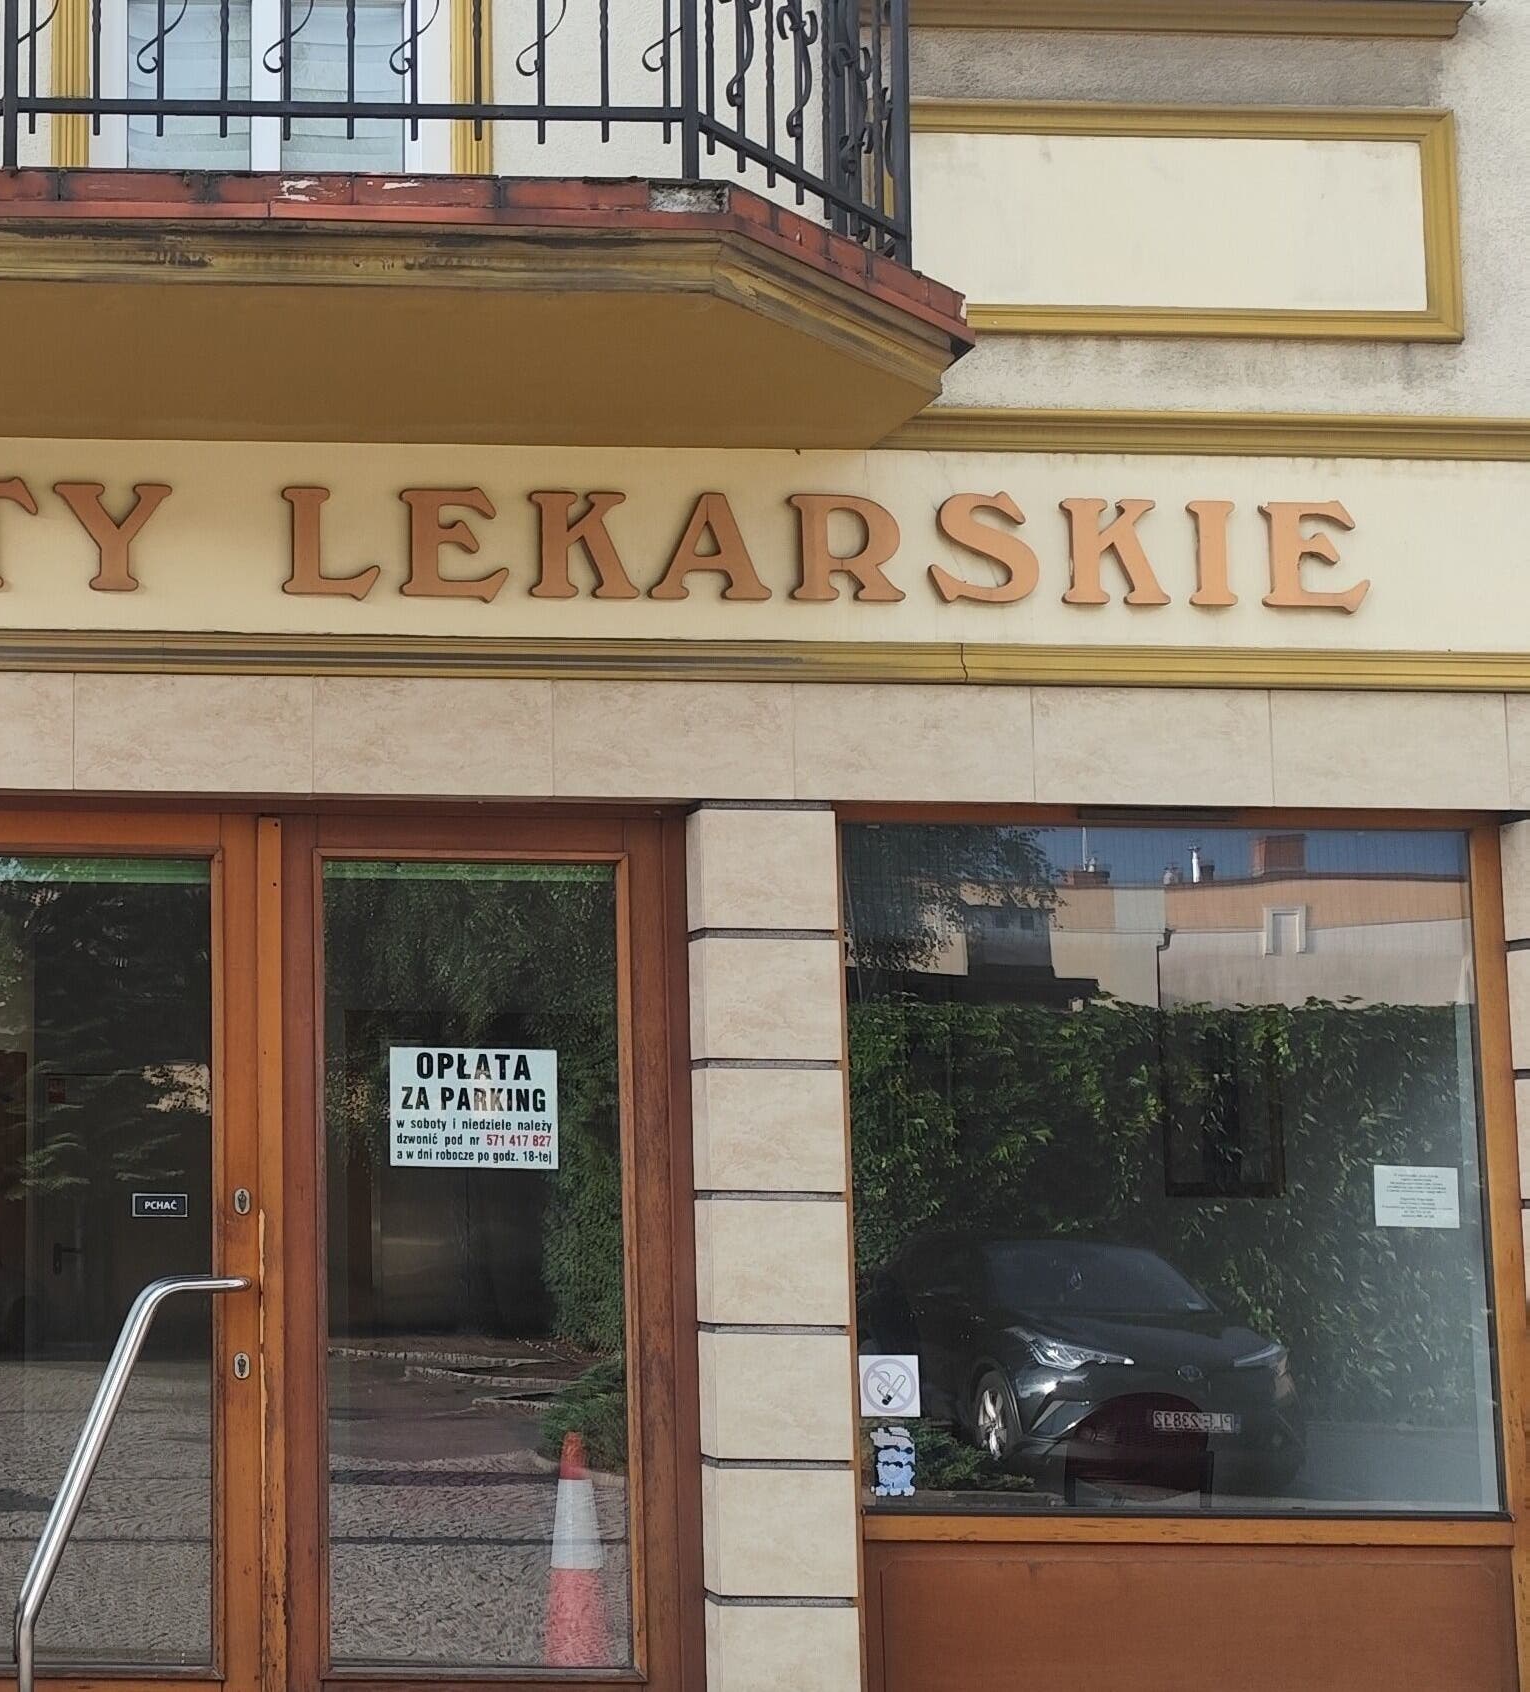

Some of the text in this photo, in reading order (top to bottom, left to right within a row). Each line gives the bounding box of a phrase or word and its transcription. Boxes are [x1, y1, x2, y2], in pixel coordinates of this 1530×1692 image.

[281, 486, 1371, 614] LEKARSKIE
[416, 1051, 532, 1081] OPŁATA
[401, 1086, 546, 1113] ZA PARKING
[396, 1117, 553, 1134] w soboty i niedziele należy
[396, 1132, 552, 1148] dzwonić pod nr 571 417 827
[396, 1148, 552, 1165] a w dni robocze po godz. 18-tej
[144, 1199, 178, 1211] PCHAĆ
